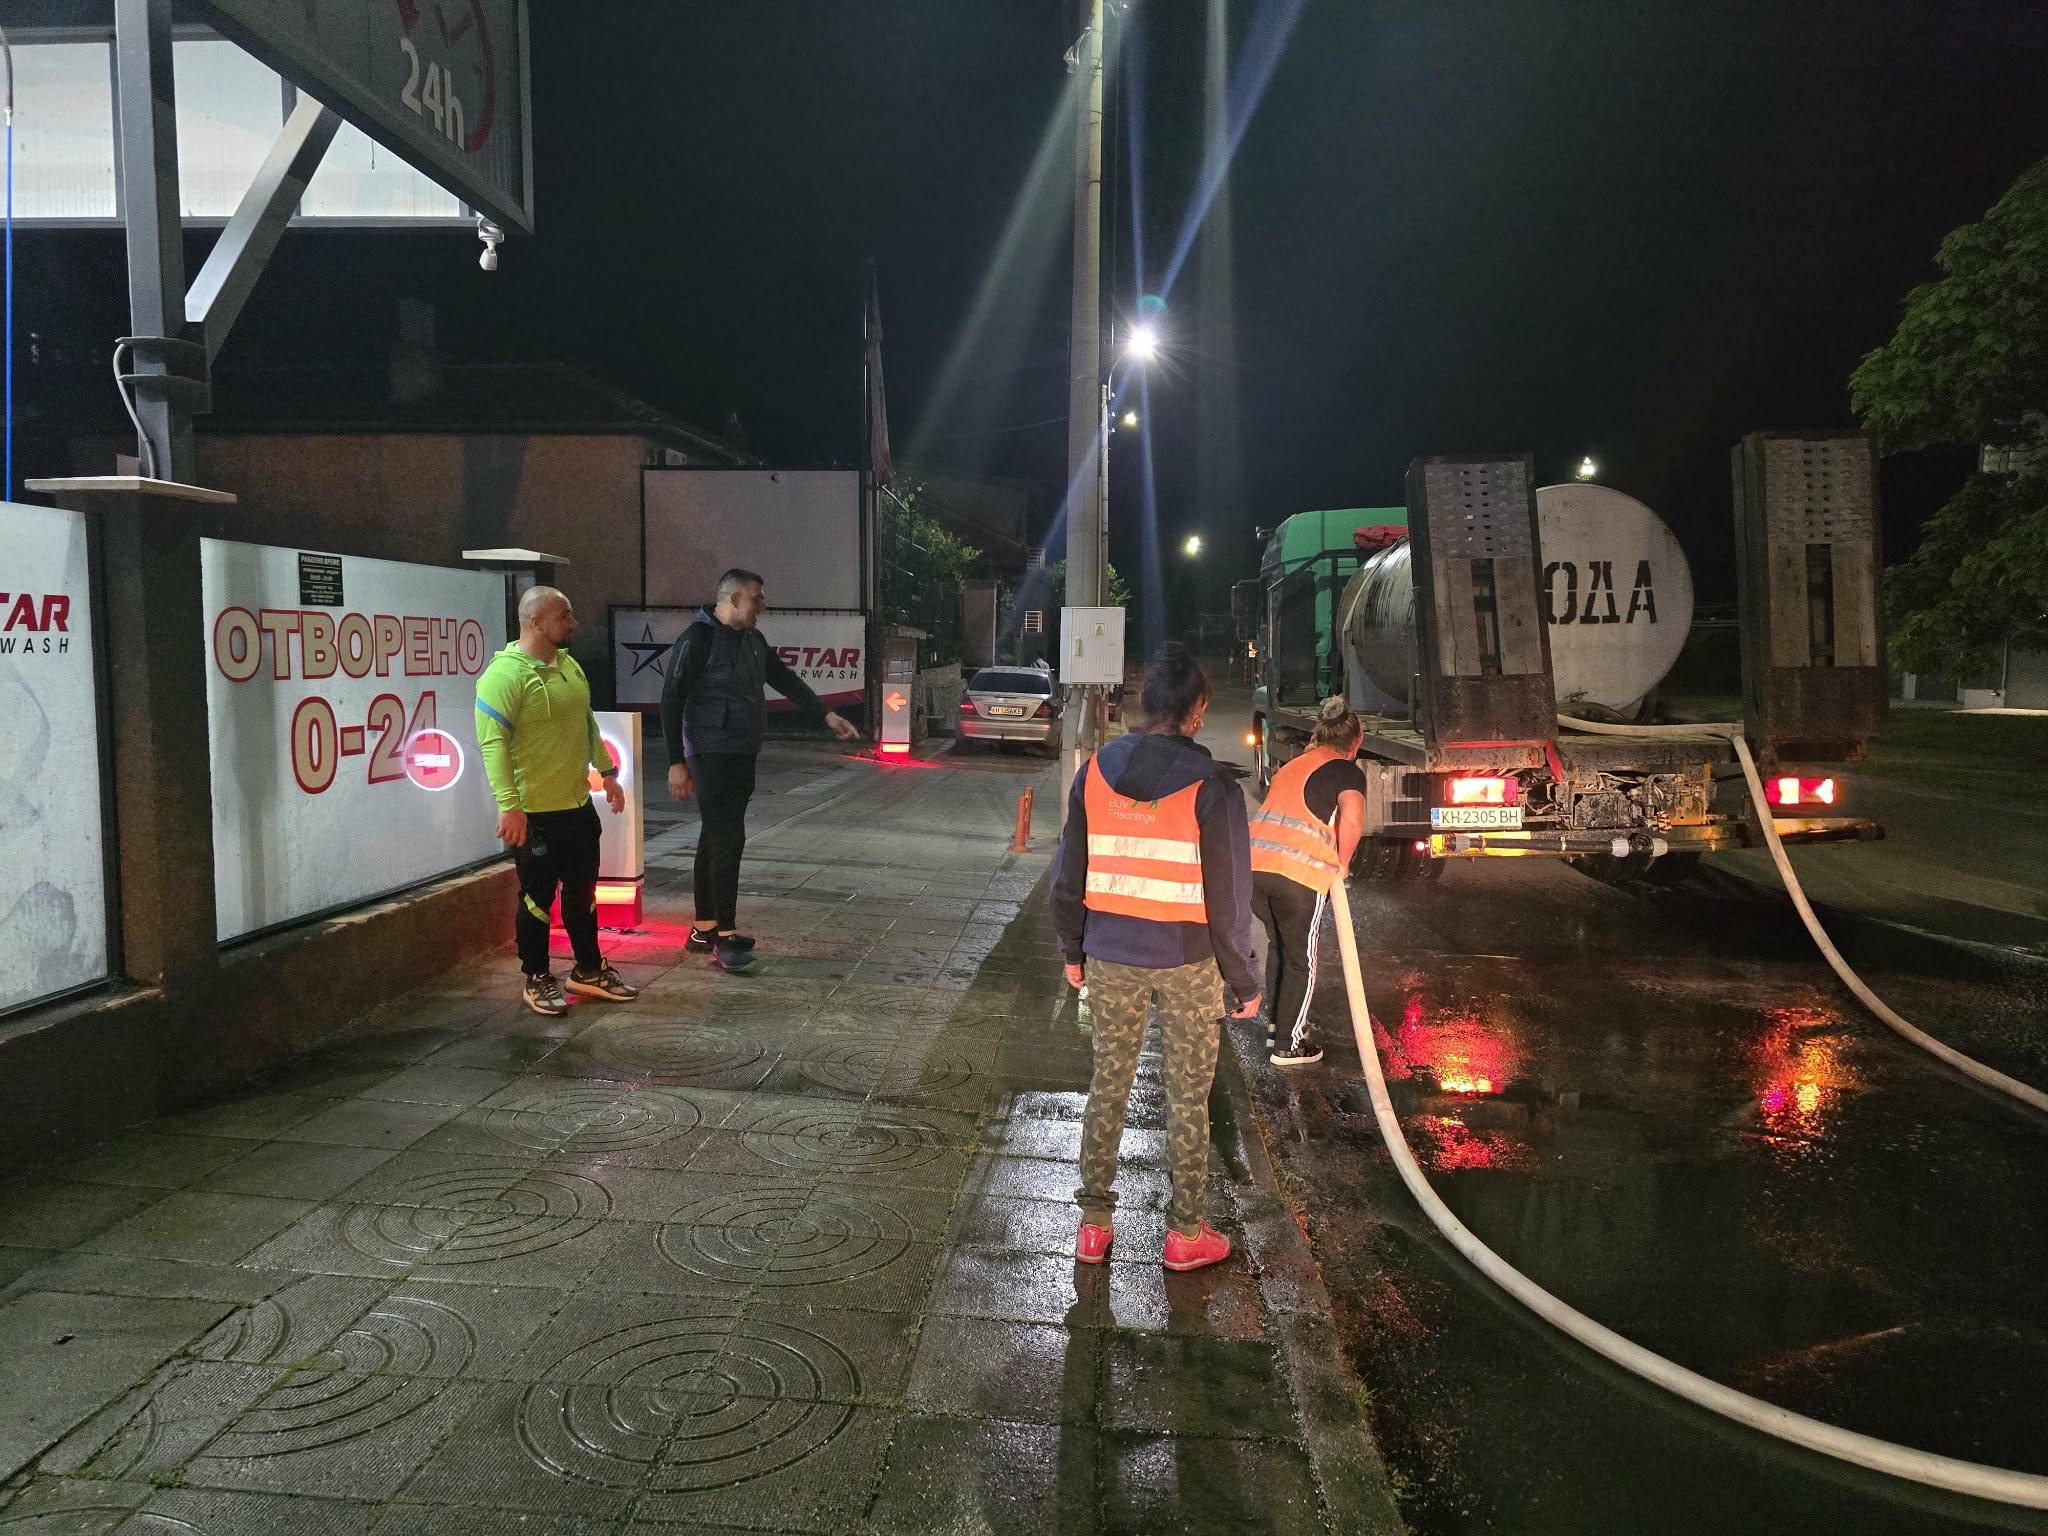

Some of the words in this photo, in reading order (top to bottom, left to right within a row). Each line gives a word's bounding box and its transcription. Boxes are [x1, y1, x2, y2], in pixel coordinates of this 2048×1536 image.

[400, 38, 465, 150] 24h
[1543, 560, 1658, 624] ОДА
[213, 606, 485, 683] ОТВОРЕНО
[776, 646, 861, 669] STAR
[800, 669, 858, 680] RWASH
[291, 690, 441, 795] 0-24
